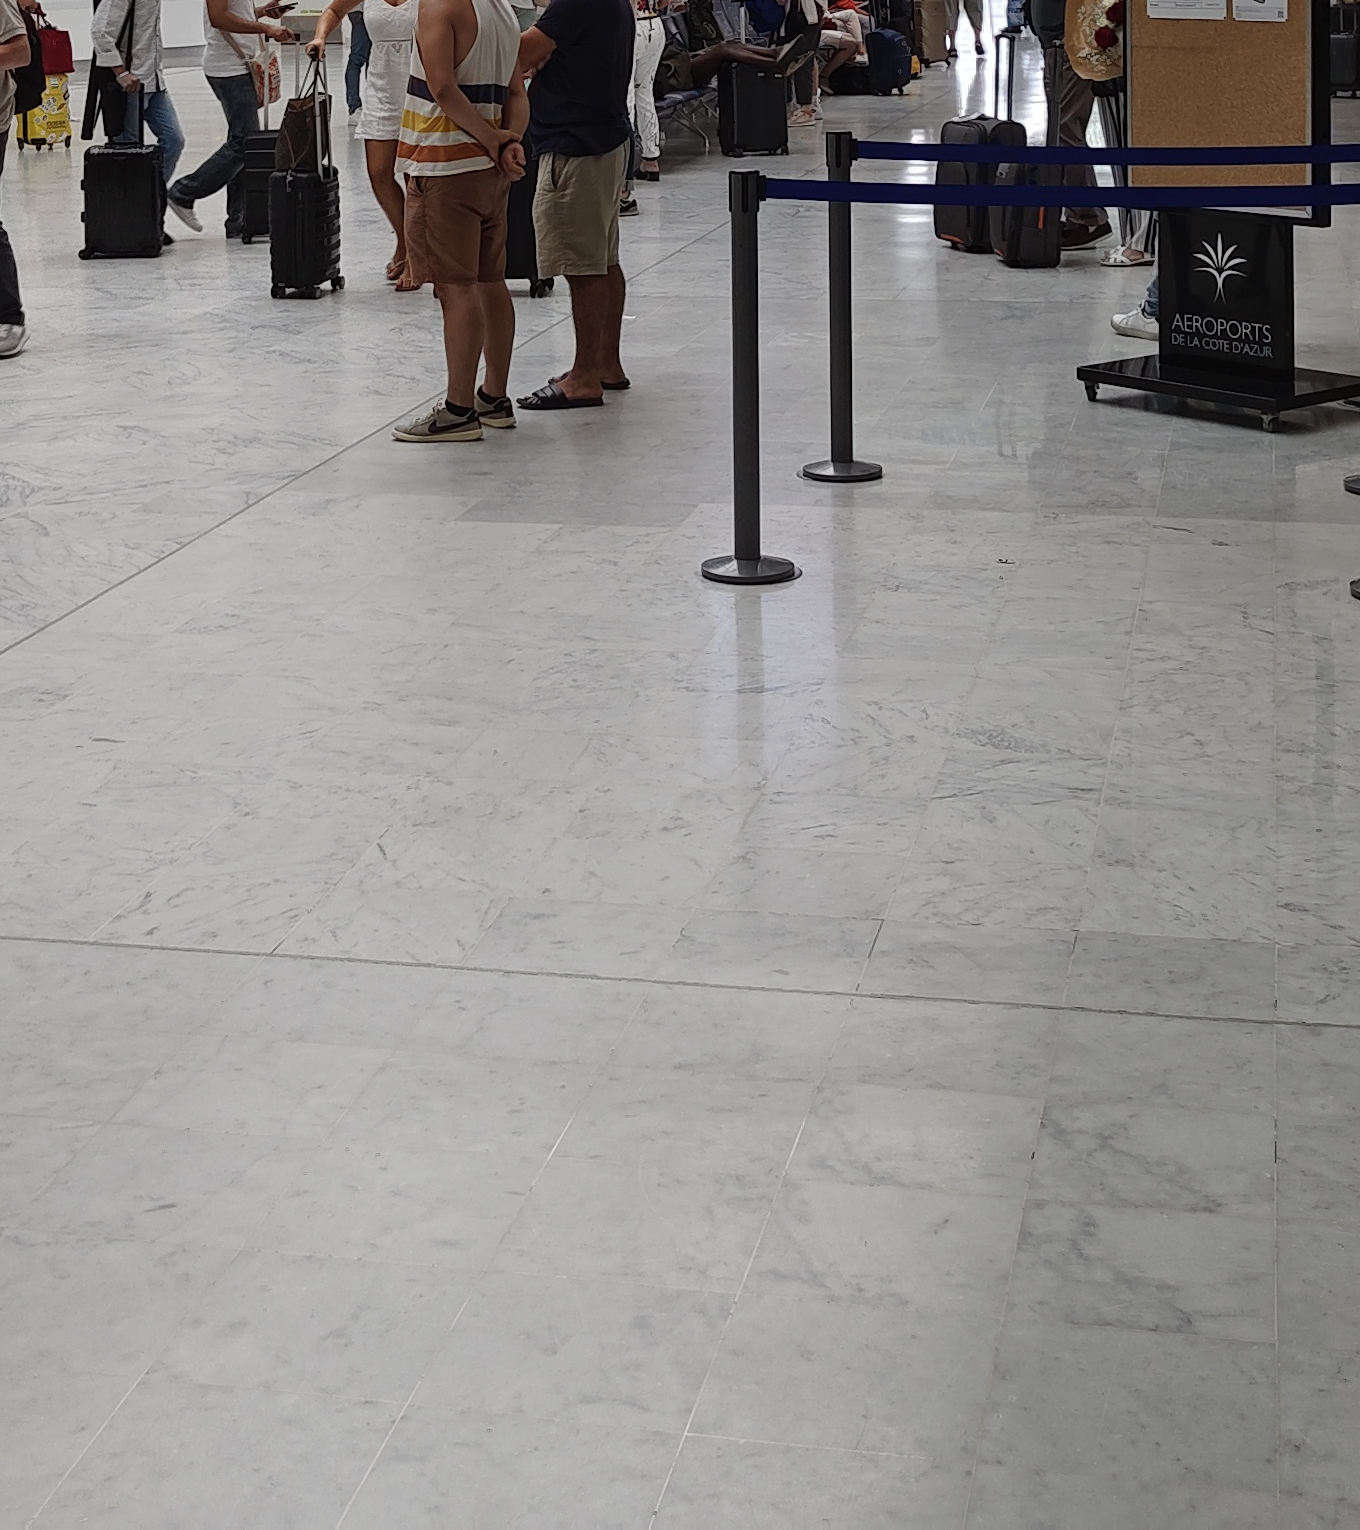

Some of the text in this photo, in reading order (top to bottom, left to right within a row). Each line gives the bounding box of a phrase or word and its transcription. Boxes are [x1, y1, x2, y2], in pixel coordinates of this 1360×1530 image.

[1171, 312, 1273, 344] AEROPORTS
[1171, 332, 1274, 359] DE LA COTE D'AZUR
